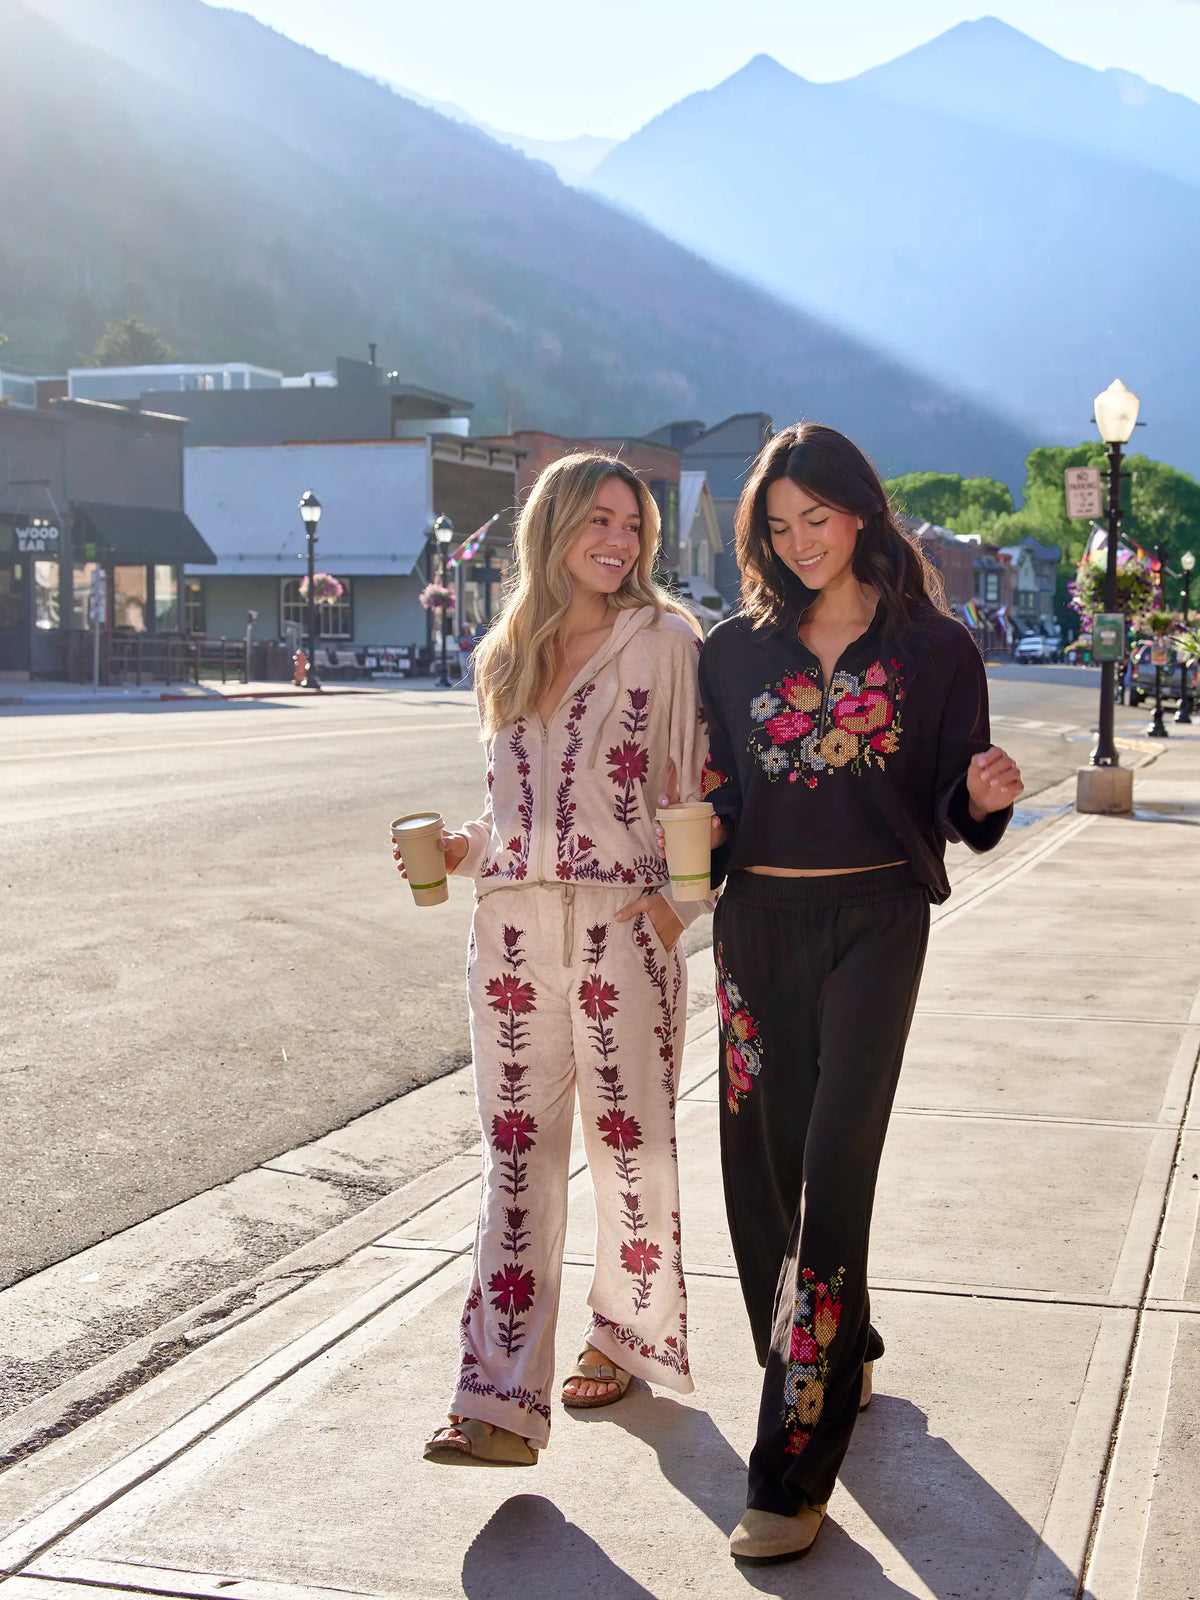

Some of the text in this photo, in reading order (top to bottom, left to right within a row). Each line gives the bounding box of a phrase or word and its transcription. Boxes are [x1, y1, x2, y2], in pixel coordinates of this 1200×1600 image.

[1076, 472, 1089, 481] NO
[1069, 482, 1097, 490] PARKING
[15, 526, 59, 539] WOOD
[19, 540, 45, 552] EAR
